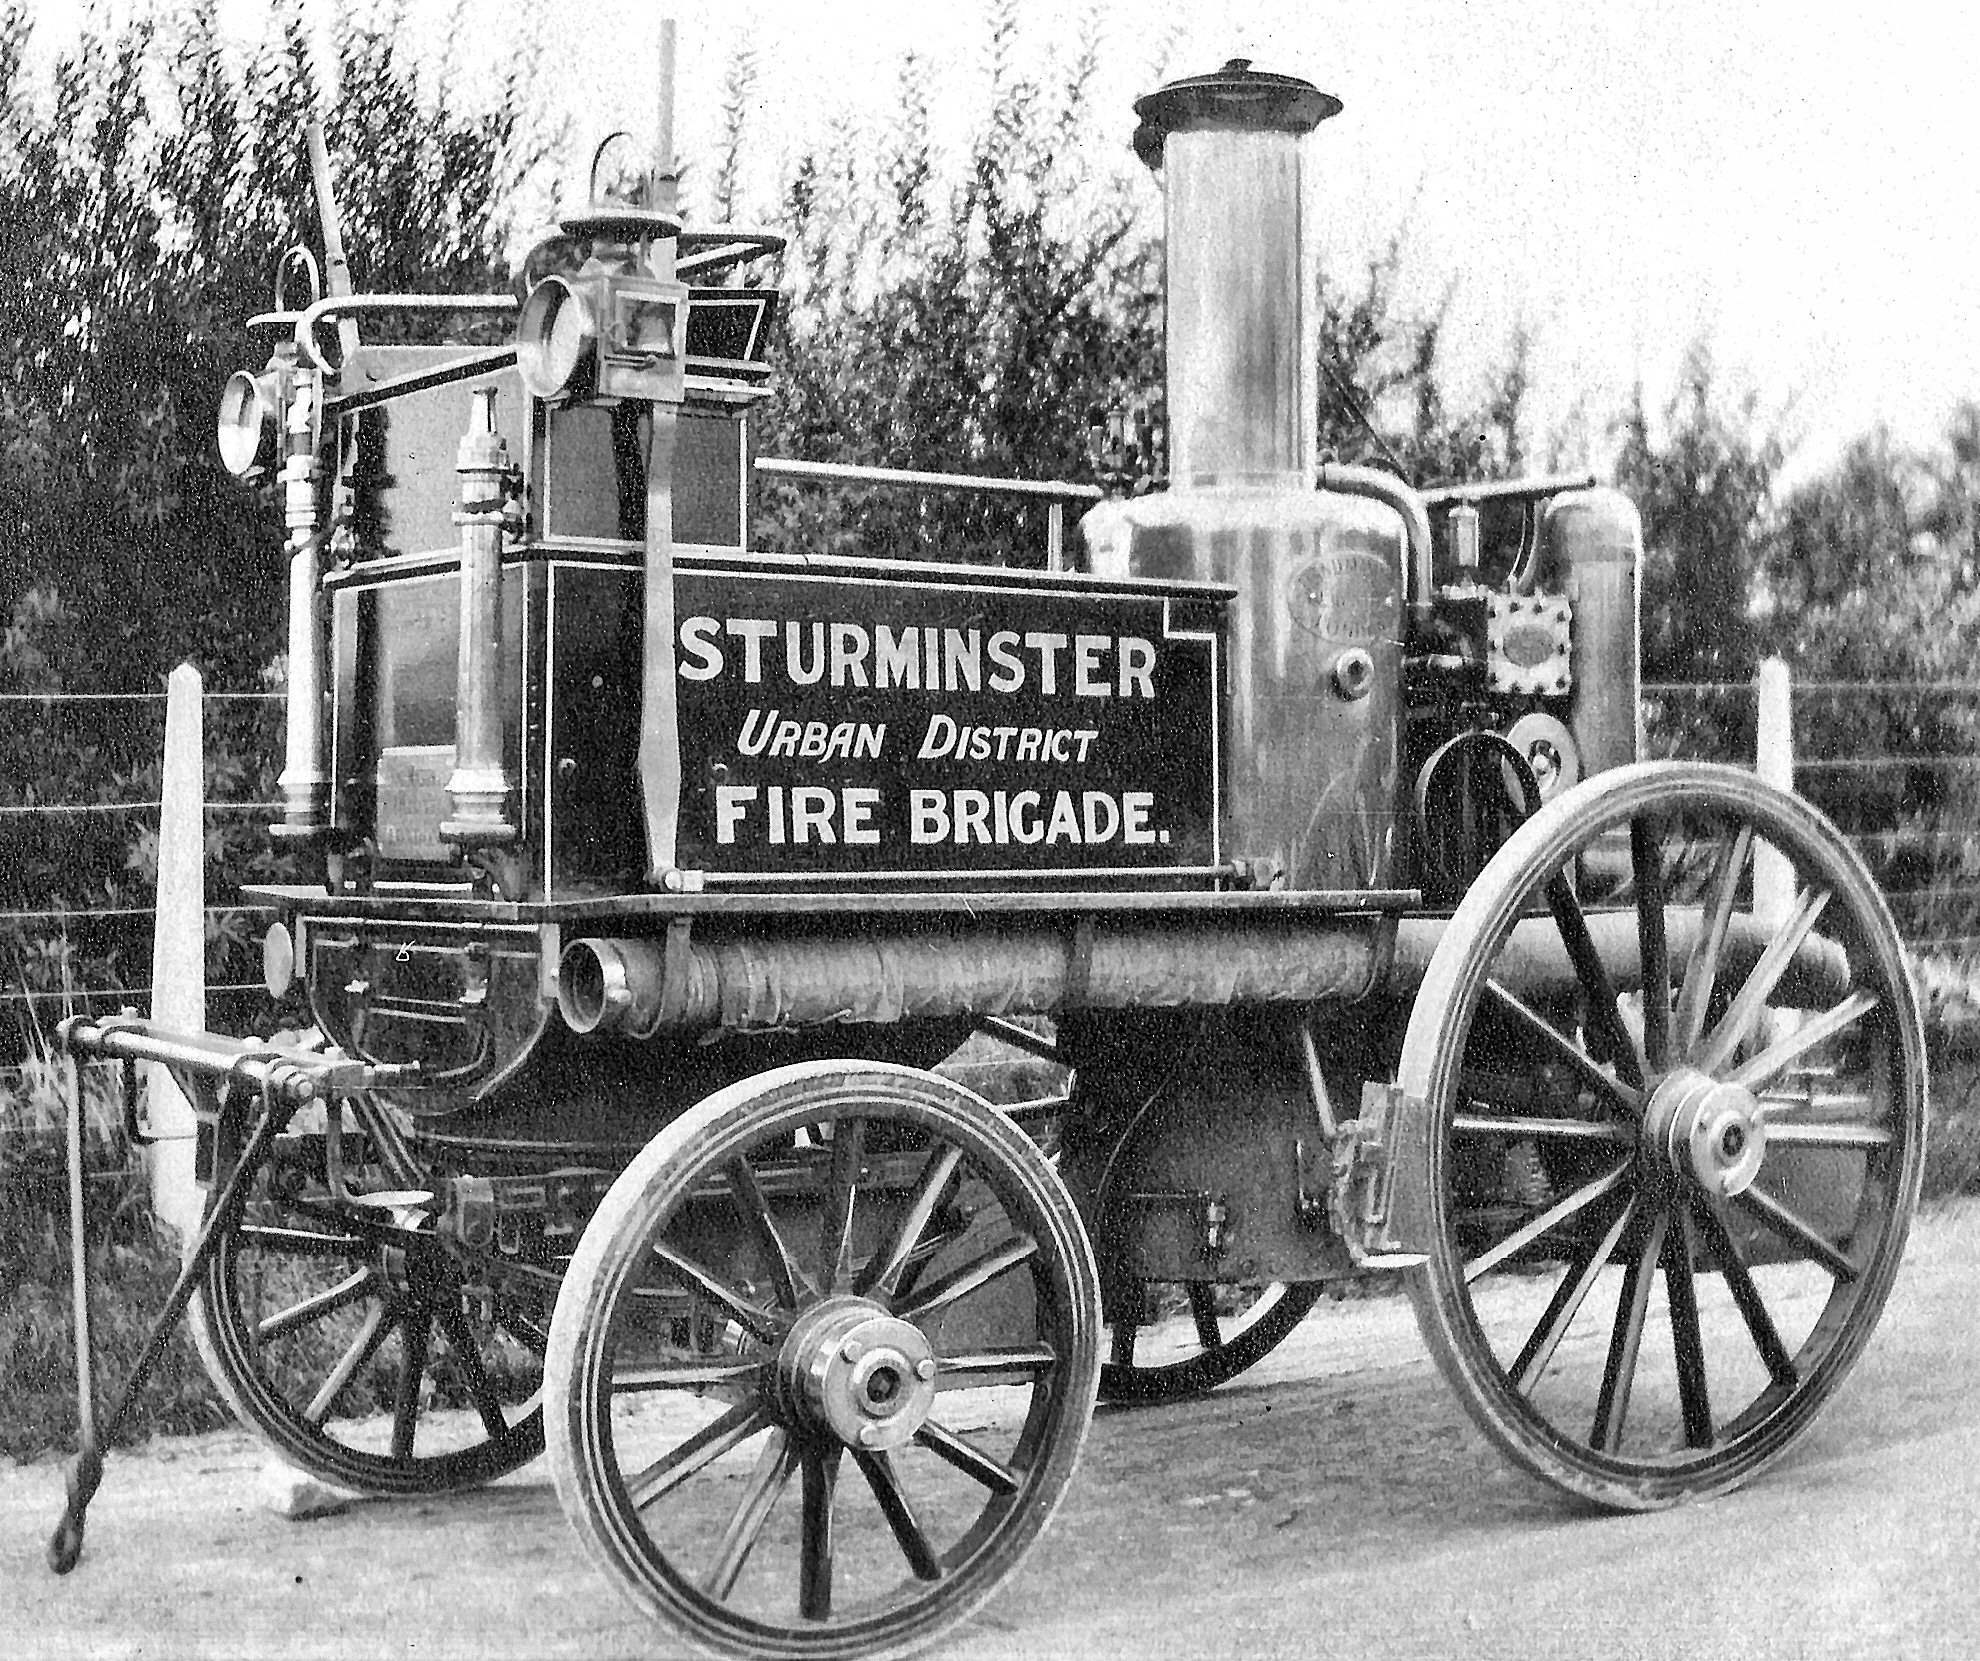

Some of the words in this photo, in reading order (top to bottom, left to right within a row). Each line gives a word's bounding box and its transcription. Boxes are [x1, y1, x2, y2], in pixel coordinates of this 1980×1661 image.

[678, 616, 1156, 699] STURMINSTER
[715, 785, 881, 845] FIRE
[910, 789, 1170, 845] BRIGADE.
